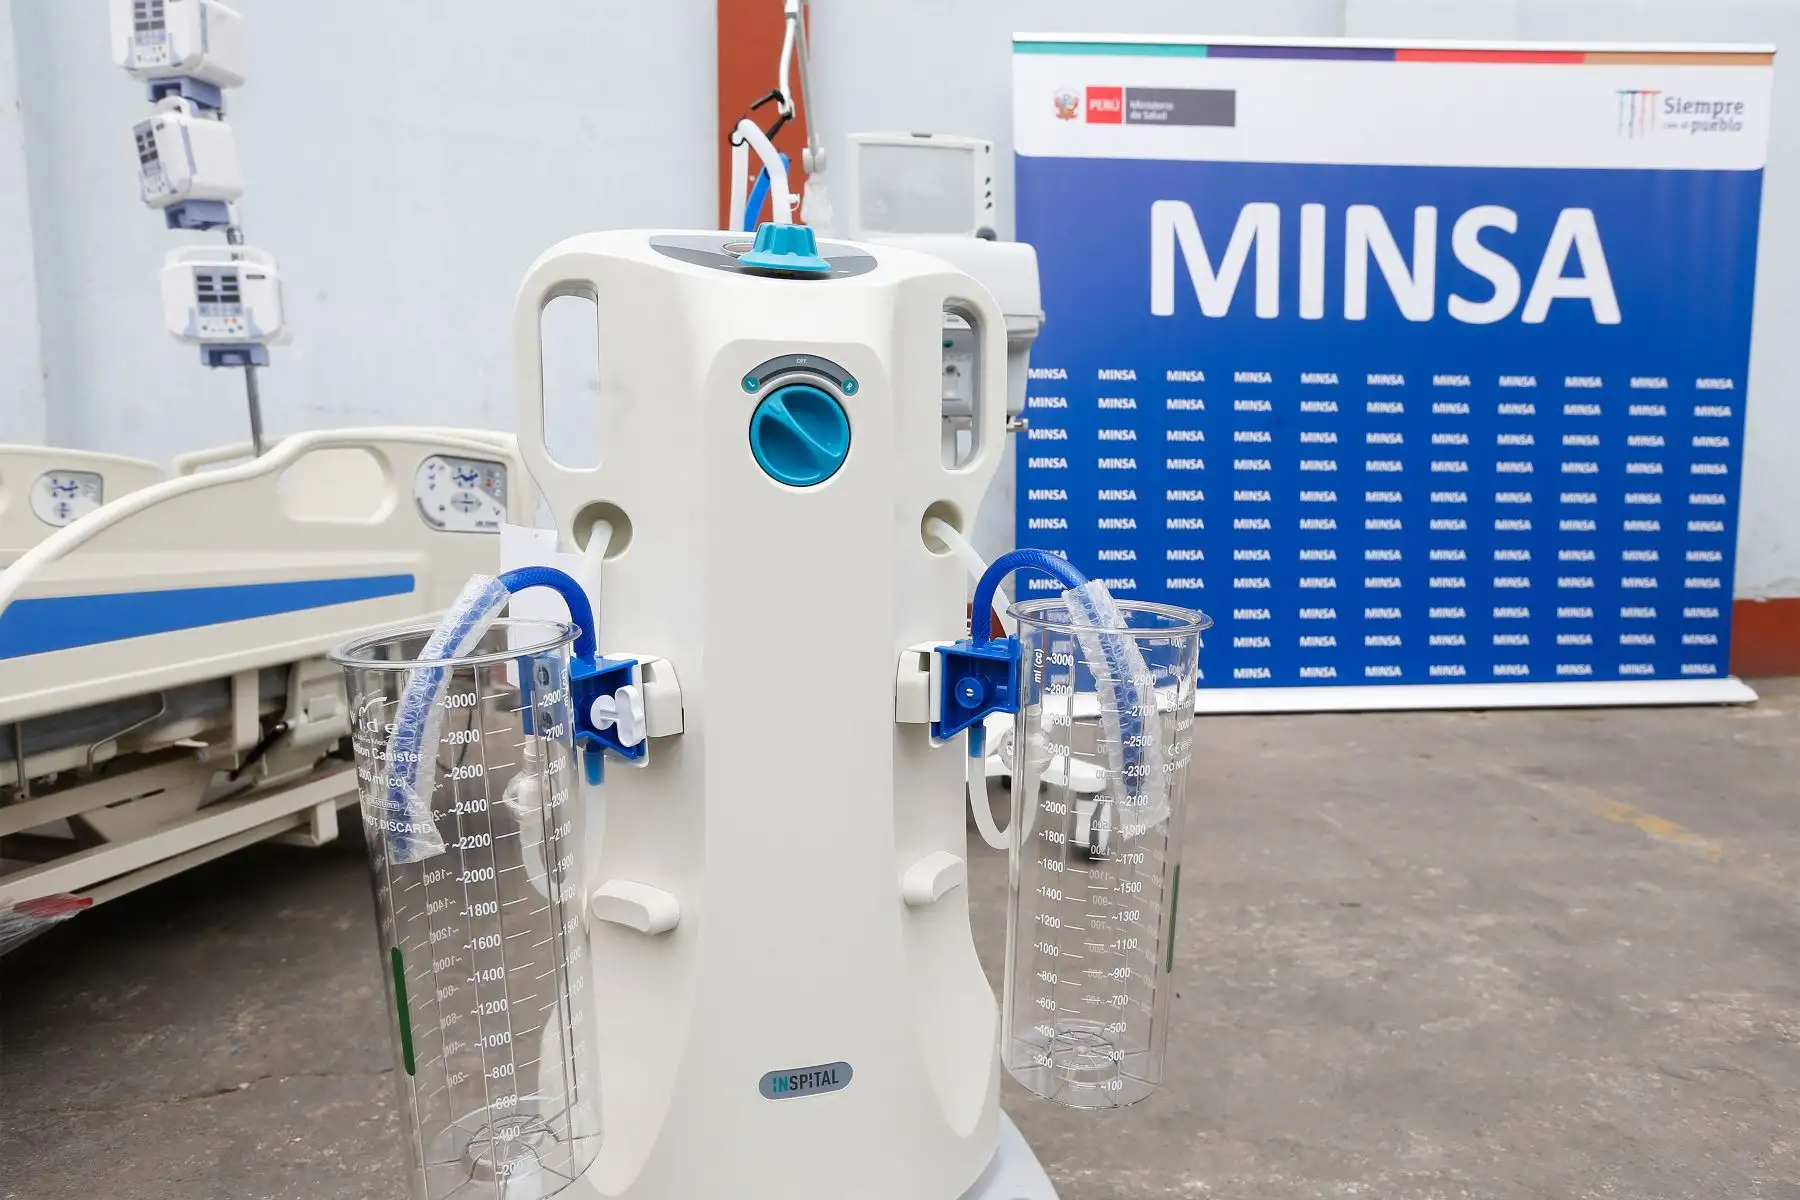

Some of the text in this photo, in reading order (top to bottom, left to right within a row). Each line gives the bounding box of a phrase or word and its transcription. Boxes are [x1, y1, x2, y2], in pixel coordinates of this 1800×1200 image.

[1664, 96, 1744, 119] Siempre
[1691, 119, 1743, 135] pueblo
[1150, 200, 1622, 324] MINSA
[748, 380, 755, 388] L
[846, 382, 853, 390] R
[1029, 368, 1733, 389] MINSA MINSA MINSA MINSA MINSA MINSA MINSA MINSA
[1029, 397, 1404, 413] MINSA MINSA MINSA MINSA MINSA MINSA
[1029, 429, 1404, 444] MINSA MINSA MINSA MINSA MINSA MINSA
[1028, 457, 1403, 472] MINSA MINSA MINSA MINSA MINSA MINSA
[1029, 489, 1402, 502] MINSA MINSA MINSA MINSA MINSA MINSA
[1029, 518, 1724, 532] MINSA MINSA MINSA MINSA MINSA MINSA MINSA MINSA
[1098, 550, 1402, 560] MINSA MINSA MINSA MINSA MINSA
[1167, 578, 1204, 589] MINSA
[1234, 578, 1270, 588] MINSA
[1300, 577, 1336, 588] MINSA
[1365, 577, 1401, 588] MINSA
[1234, 608, 1401, 620] MINSA MINSA MINSA
[1234, 635, 1402, 648] MINSA MINSA MINSA
[1234, 664, 1717, 679] MINSA MINSA MINSA MINSA MINSA
[436, 692, 476, 709] ~3000
[440, 729, 480, 745] ~2800
[444, 764, 483, 781] ~2600
[386, 776, 406, 788] (cc)
[448, 799, 487, 815] ~2400
[380, 820, 431, 833] DISCARD
[452, 833, 491, 849] ~2200
[456, 867, 494, 883] ~2000
[459, 901, 498, 917] ~1800
[463, 934, 501, 951] ~1600
[467, 967, 504, 983] ~1400
[470, 999, 507, 1016] ~1200
[474, 1031, 511, 1048] ~1000
[485, 1063, 514, 1079] ~800
[773, 1069, 839, 1092] INSPITAL
